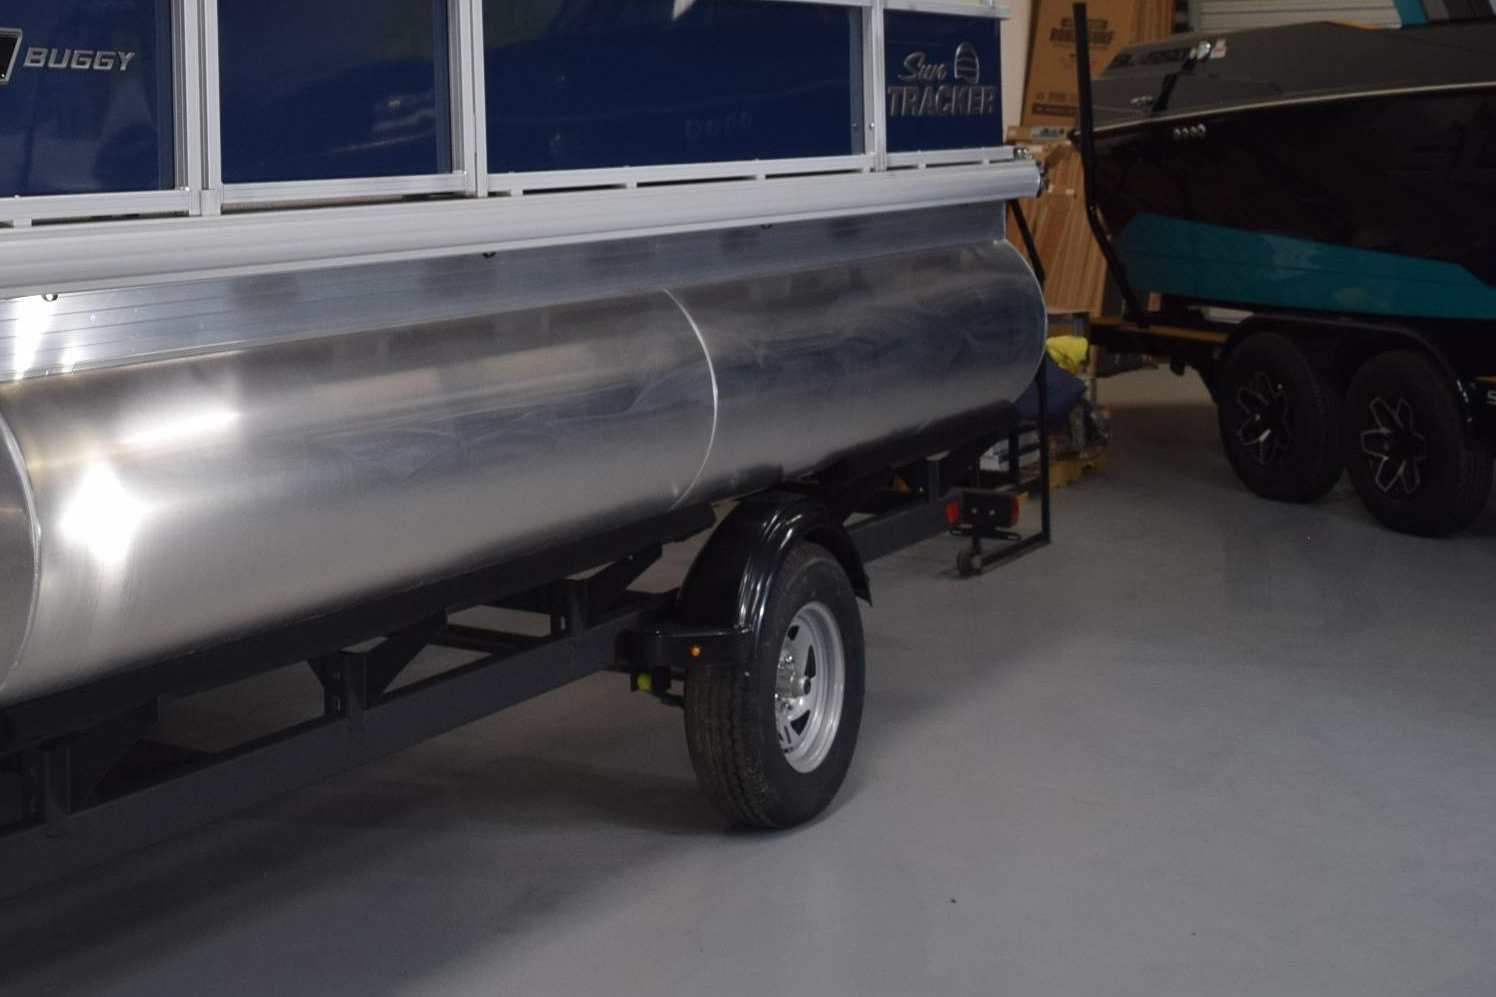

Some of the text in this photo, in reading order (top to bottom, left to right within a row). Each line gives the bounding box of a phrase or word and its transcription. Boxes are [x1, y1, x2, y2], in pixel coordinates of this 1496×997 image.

[22, 46, 136, 72] BUGGY
[897, 51, 947, 81] Sun
[887, 85, 997, 117] TRACKER
